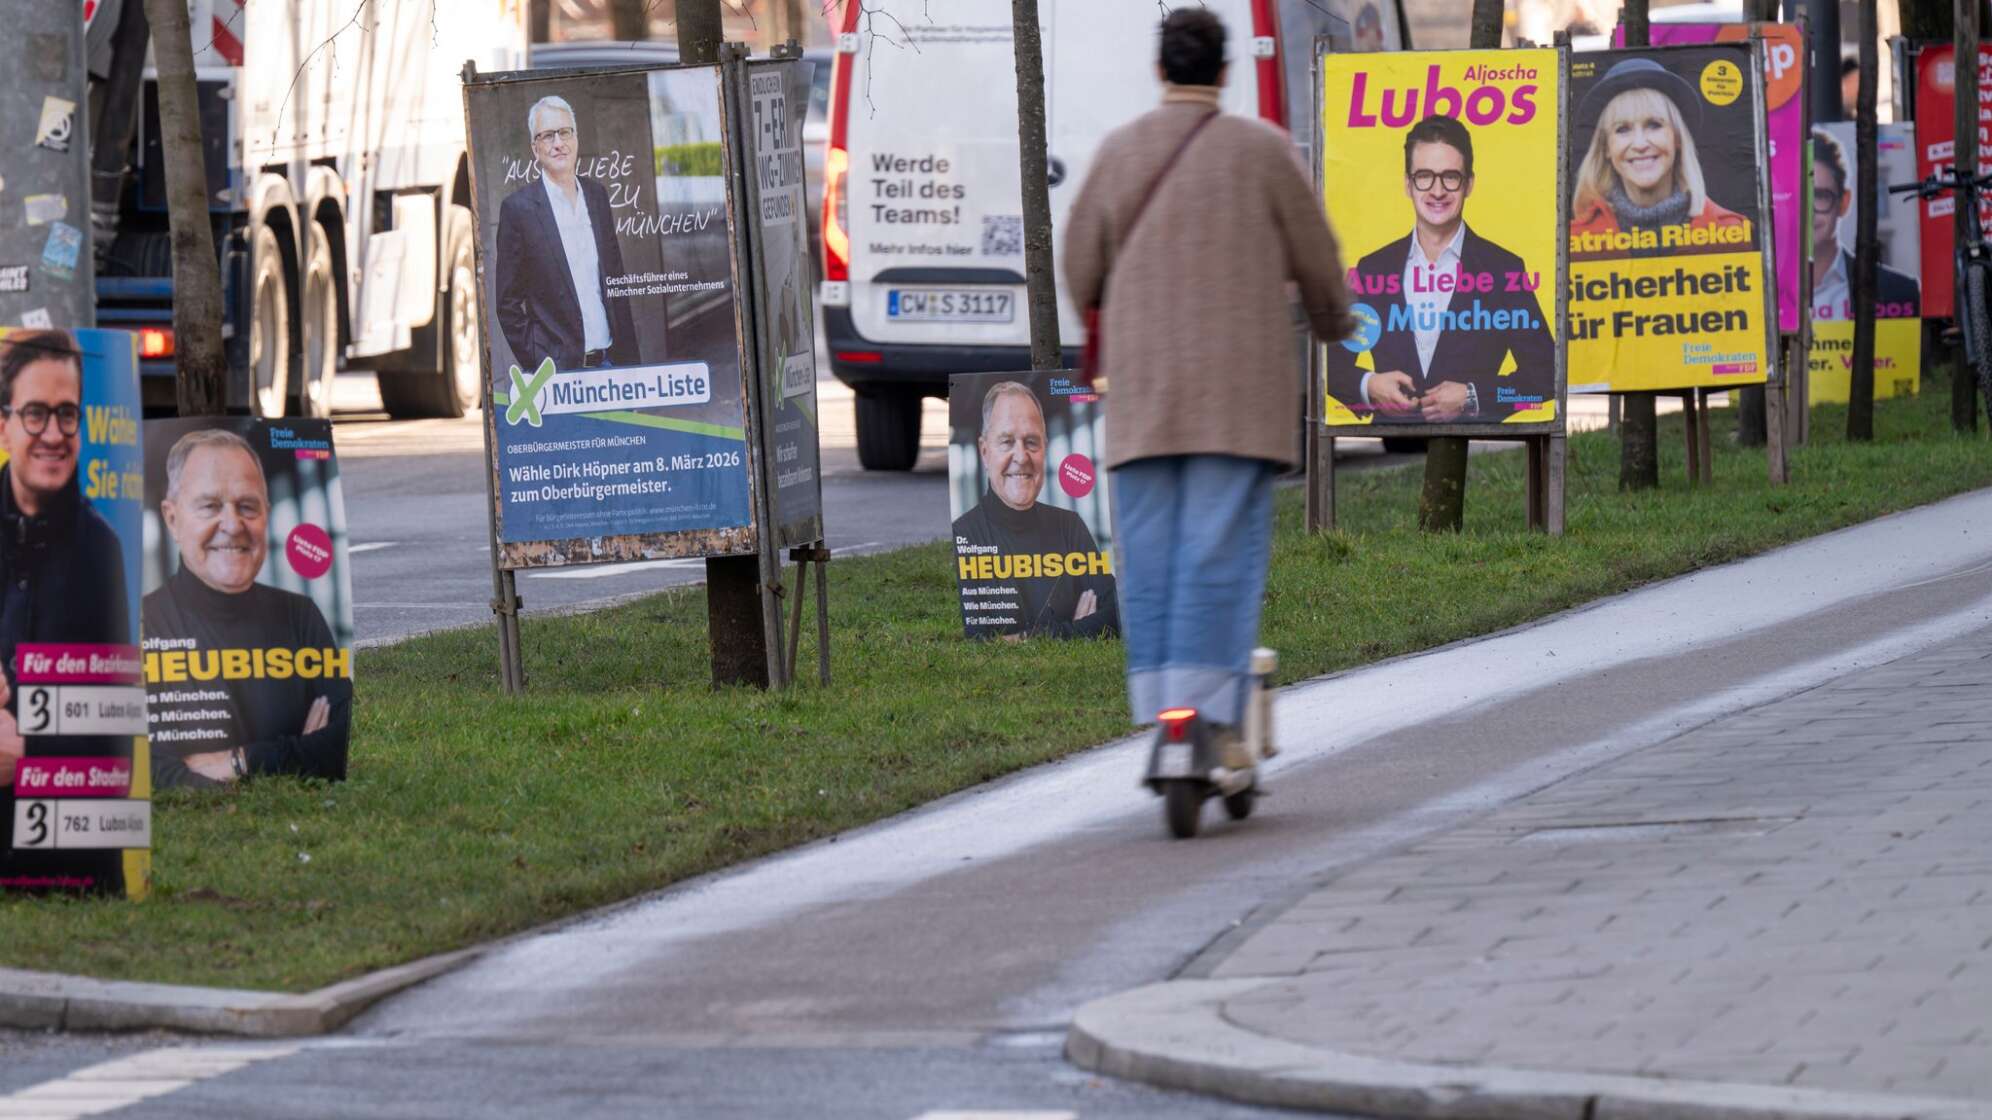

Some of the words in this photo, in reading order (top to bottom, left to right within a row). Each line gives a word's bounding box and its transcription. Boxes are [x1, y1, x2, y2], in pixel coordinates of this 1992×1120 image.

[1463, 64, 1537, 84] Aljoscha
[1717, 66, 1727, 76] 3
[1347, 65, 1538, 128] Lubos
[575, 150, 635, 178] LIEBE
[872, 153, 950, 173] Werde
[609, 183, 641, 208] ZU
[871, 179, 912, 198] Teil
[919, 180, 965, 199] des
[871, 204, 960, 224] Teams!
[1569, 226, 1657, 252] atricia
[1661, 219, 1751, 248] Riekel
[870, 243, 903, 254] Mehr
[908, 243, 942, 255] Infos
[946, 243, 974, 255] hier
[606, 273, 667, 285] Geschäftsführer
[668, 271, 688, 281] eines
[1347, 267, 1400, 295] Aus
[1413, 262, 1494, 293] Liebe
[1503, 271, 1540, 292] zu
[607, 286, 646, 298] Münchner
[647, 280, 725, 295] Sozialunternehmens
[901, 293, 927, 313] CW
[941, 293, 953, 313] S
[958, 293, 1008, 314] 3117
[1387, 299, 1540, 332] München.
[1568, 312, 1605, 341] ür
[1613, 309, 1748, 338] Frauen
[1682, 343, 1712, 352] Freie
[1683, 352, 1757, 365] Demokraten
[552, 373, 706, 406] München-Liste
[1050, 378, 1070, 386] Freie
[1496, 386, 1516, 394] Freie
[1496, 394, 1543, 403] Demokraten
[270, 427, 294, 438] Freie
[271, 437, 330, 449] Demokraten
[507, 439, 591, 454] OBERBÜRGERMEISTER
[591, 437, 606, 448] FÜR
[607, 435, 646, 447] MÜNCHEN
[509, 464, 551, 482] Wähle
[553, 461, 580, 479] Dirk
[583, 460, 631, 480] Höpner
[633, 460, 653, 474] am
[656, 457, 669, 471] 8.
[671, 454, 704, 471] März
[706, 451, 740, 468] 2026
[86, 458, 118, 499] Sie
[511, 489, 539, 503] zum
[542, 478, 671, 500] Oberbürgermeister.
[956, 536, 969, 545] Dr.
[957, 544, 998, 555] Wolfgang
[958, 551, 1113, 580] HEUBISCH
[961, 587, 977, 596] Aus
[978, 586, 1018, 596] München.
[963, 602, 979, 610] Wie
[980, 601, 1019, 610] München.
[965, 616, 977, 625] Für
[978, 615, 1017, 625] München.
[141, 637, 197, 651] olfgang
[22, 652, 53, 674] Für
[56, 652, 87, 674] den
[143, 647, 351, 683] HEUBISCH
[160, 690, 229, 703] München.
[24, 688, 50, 732] 3
[65, 703, 89, 718] 601
[161, 708, 231, 723] München.
[157, 729, 228, 742] München.
[20, 766, 51, 787] Für
[53, 766, 86, 787] den
[22, 802, 48, 845] 3
[64, 816, 90, 832] 762
